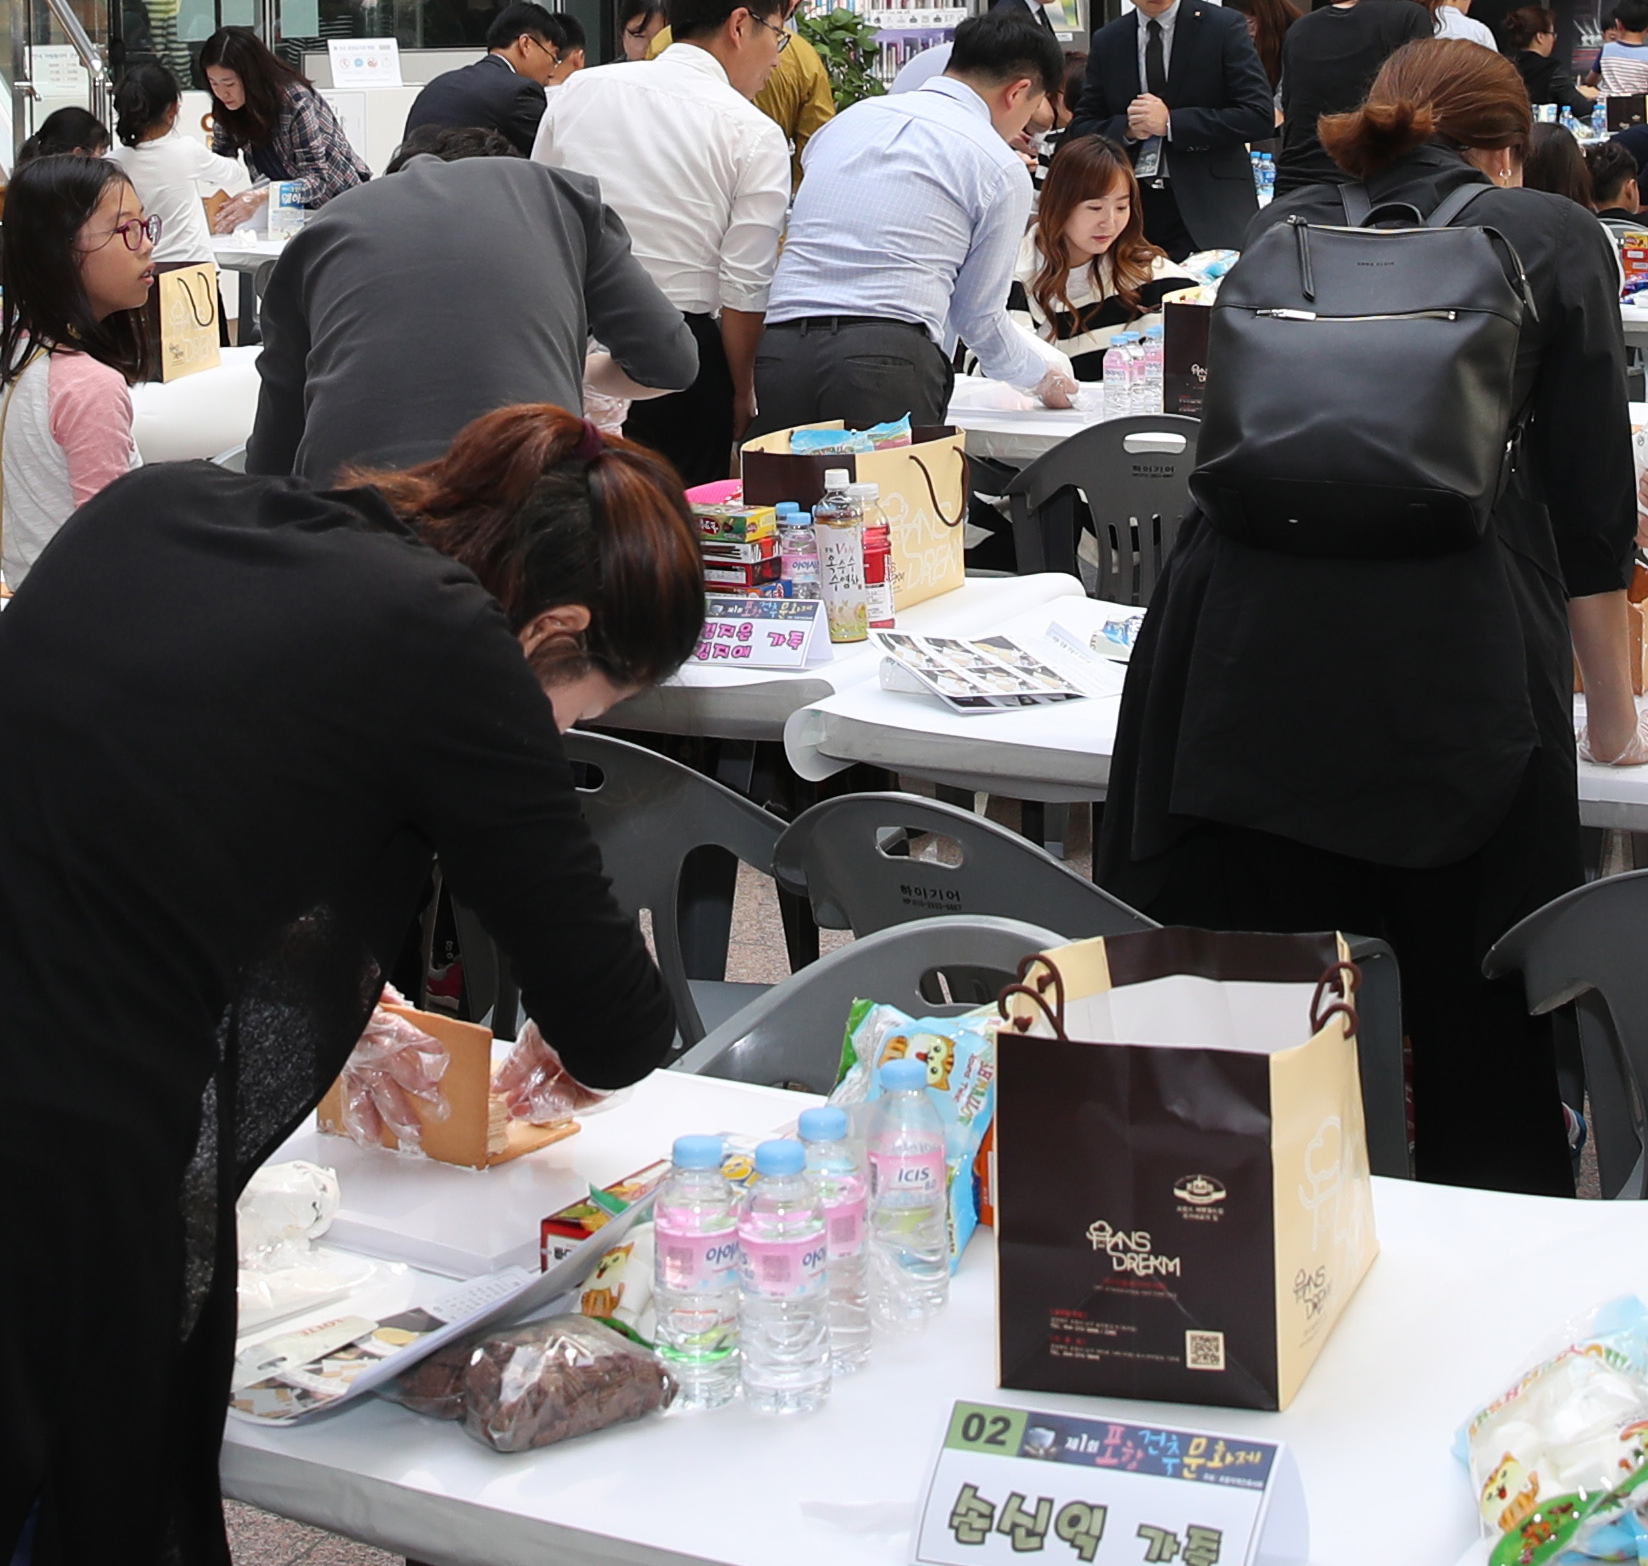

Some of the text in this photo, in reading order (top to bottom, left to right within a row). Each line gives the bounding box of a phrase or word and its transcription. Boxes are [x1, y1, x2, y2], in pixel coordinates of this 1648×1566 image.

[898, 1167, 930, 1183] ICIS
[1086, 1221, 1152, 1253] HANS
[961, 1412, 1012, 1446] 02
[1064, 1432, 1099, 1453] 제1회
